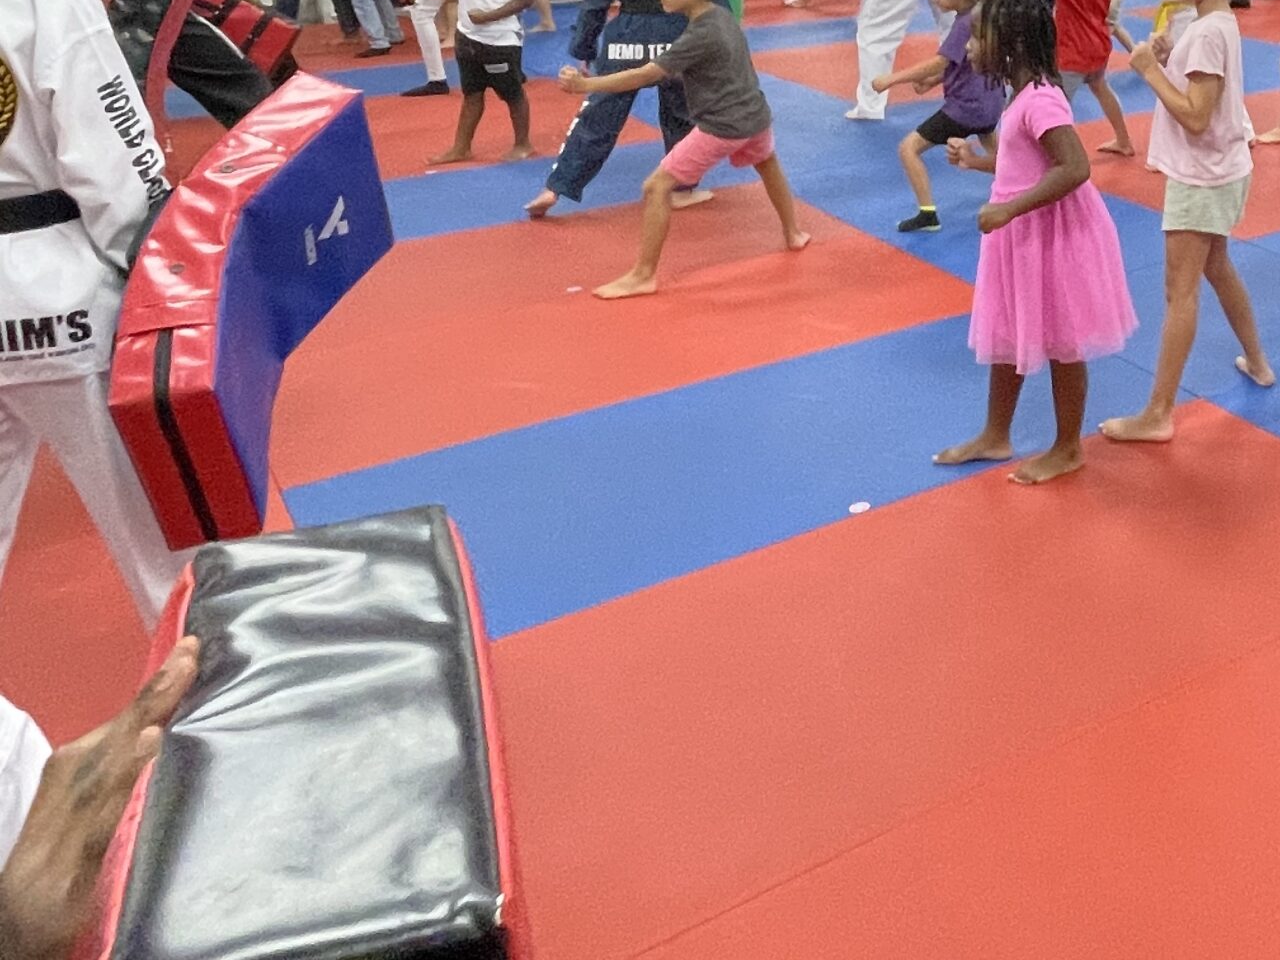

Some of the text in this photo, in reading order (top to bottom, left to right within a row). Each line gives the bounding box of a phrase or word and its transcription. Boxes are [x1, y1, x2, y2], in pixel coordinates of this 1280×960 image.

[608, 43, 644, 60] DEMO
[97, 74, 145, 149] WORLD
[0, 309, 93, 352] IM'S
